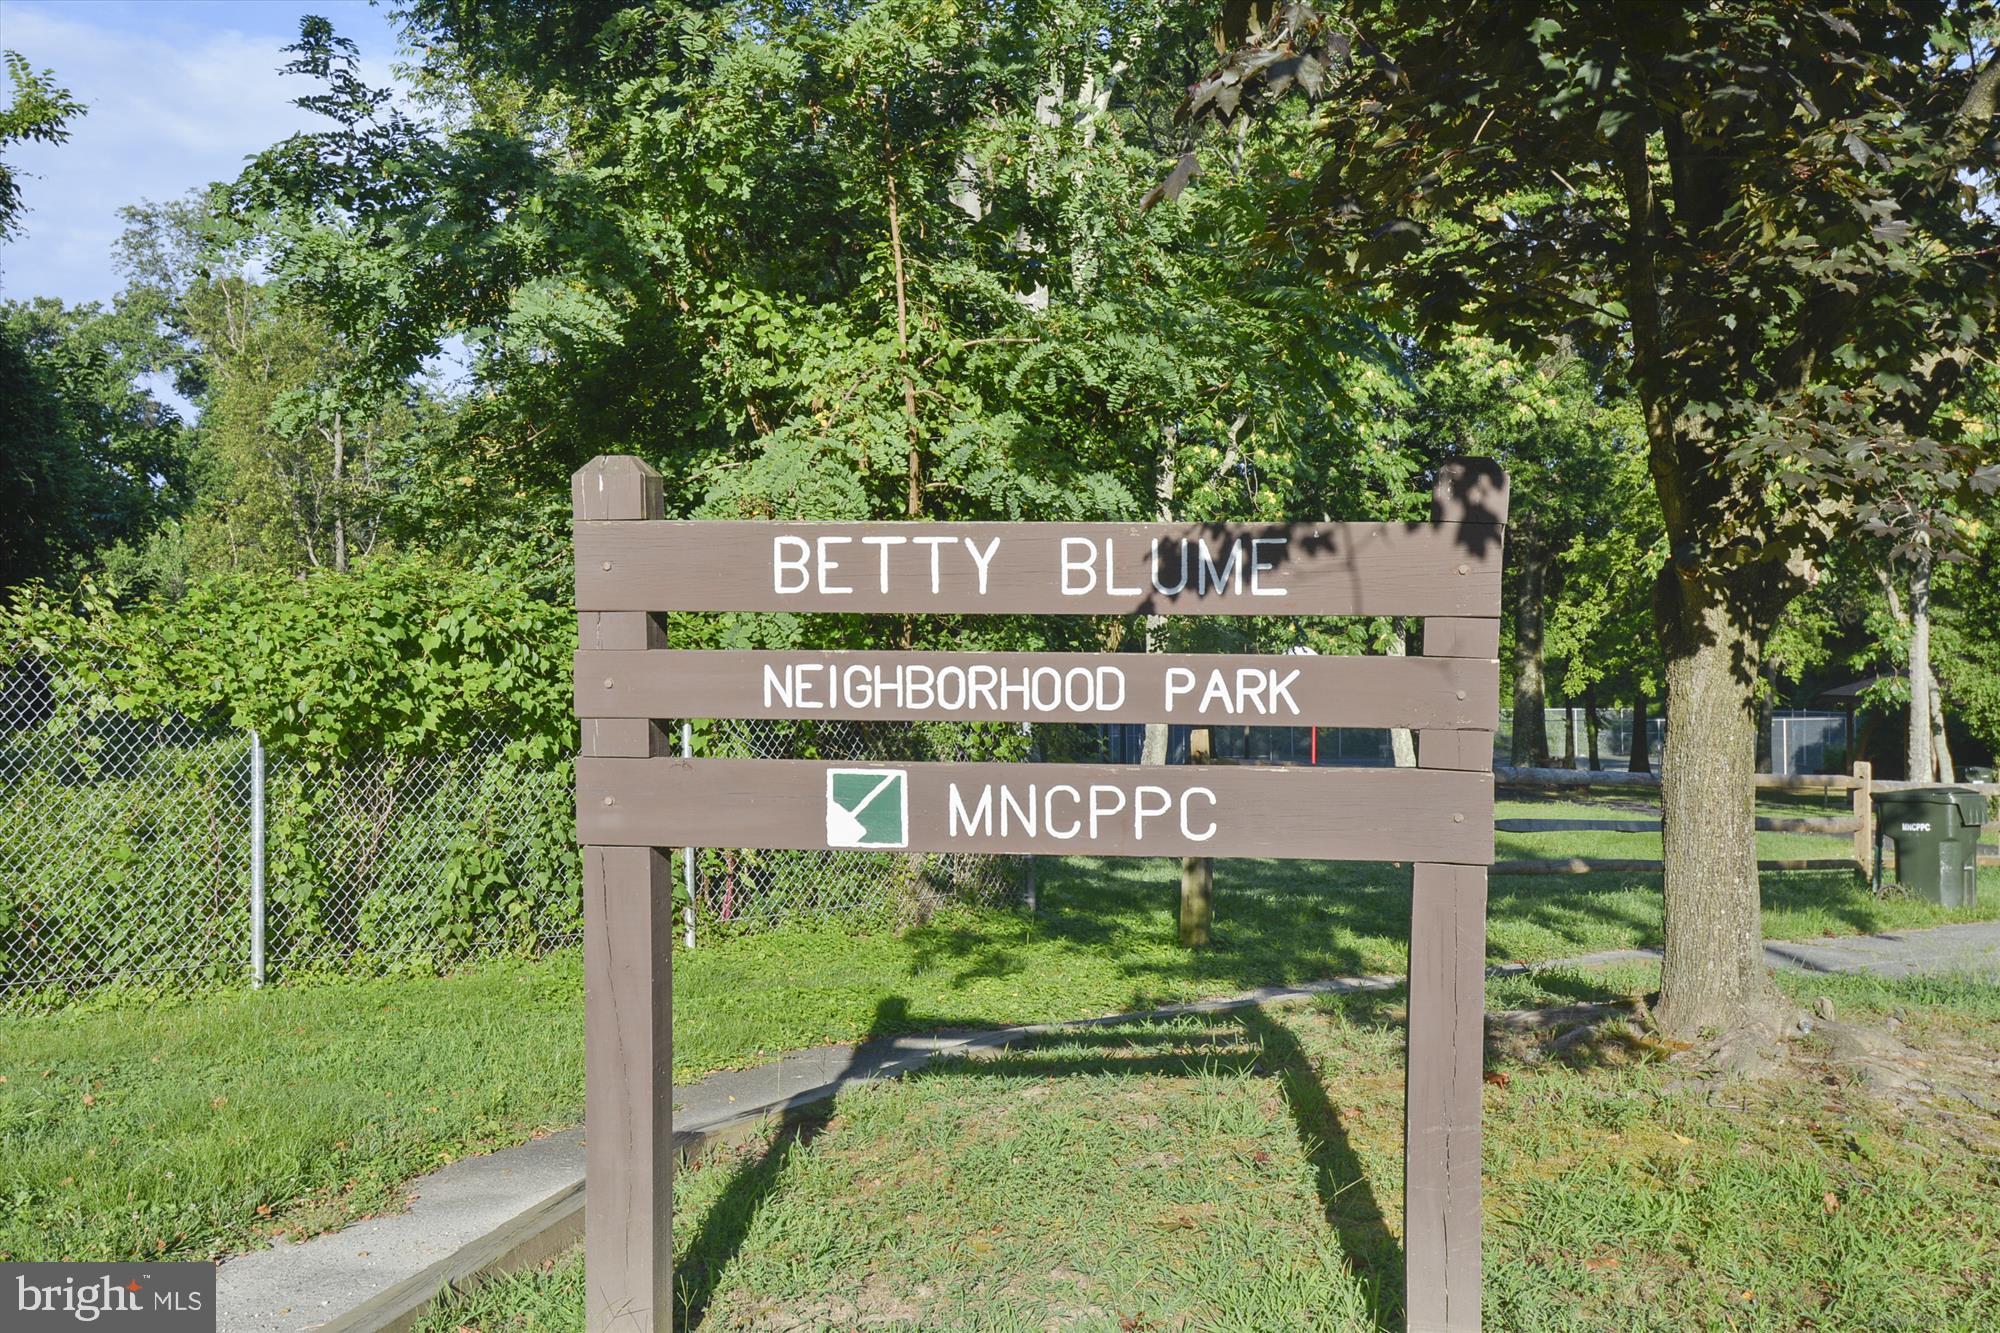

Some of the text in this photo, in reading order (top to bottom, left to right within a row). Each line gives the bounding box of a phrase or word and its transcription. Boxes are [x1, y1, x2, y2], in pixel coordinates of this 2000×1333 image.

[773, 536, 1288, 597] BETTY BLUME
[763, 664, 1301, 716] NEIGHBORHOOD PARK
[948, 783, 1217, 841] MNCPPC
[1902, 823, 1931, 832] MNCPPC
